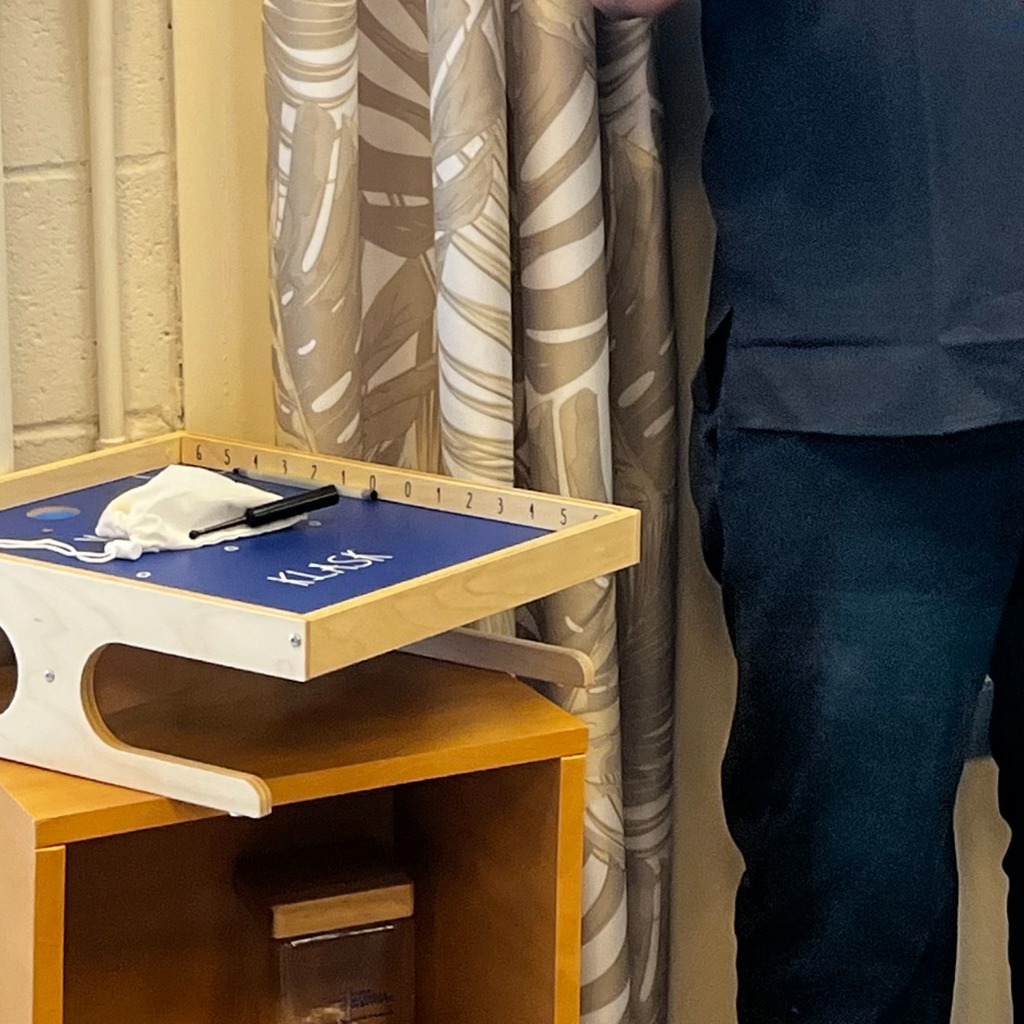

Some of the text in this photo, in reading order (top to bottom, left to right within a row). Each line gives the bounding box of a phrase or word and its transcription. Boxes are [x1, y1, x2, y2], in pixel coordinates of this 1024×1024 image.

[195, 444, 202, 461] 6
[223, 449, 231, 465] 5
[281, 460, 288, 475] 3
[341, 470, 346, 485] 1
[369, 475, 376, 491] 0
[404, 481, 411, 498] 0
[436, 487, 441, 503] 1
[465, 492, 473, 509] 2
[497, 497, 504, 514] 3
[560, 508, 567, 525] 5
[266, 549, 394, 587] KLASK
